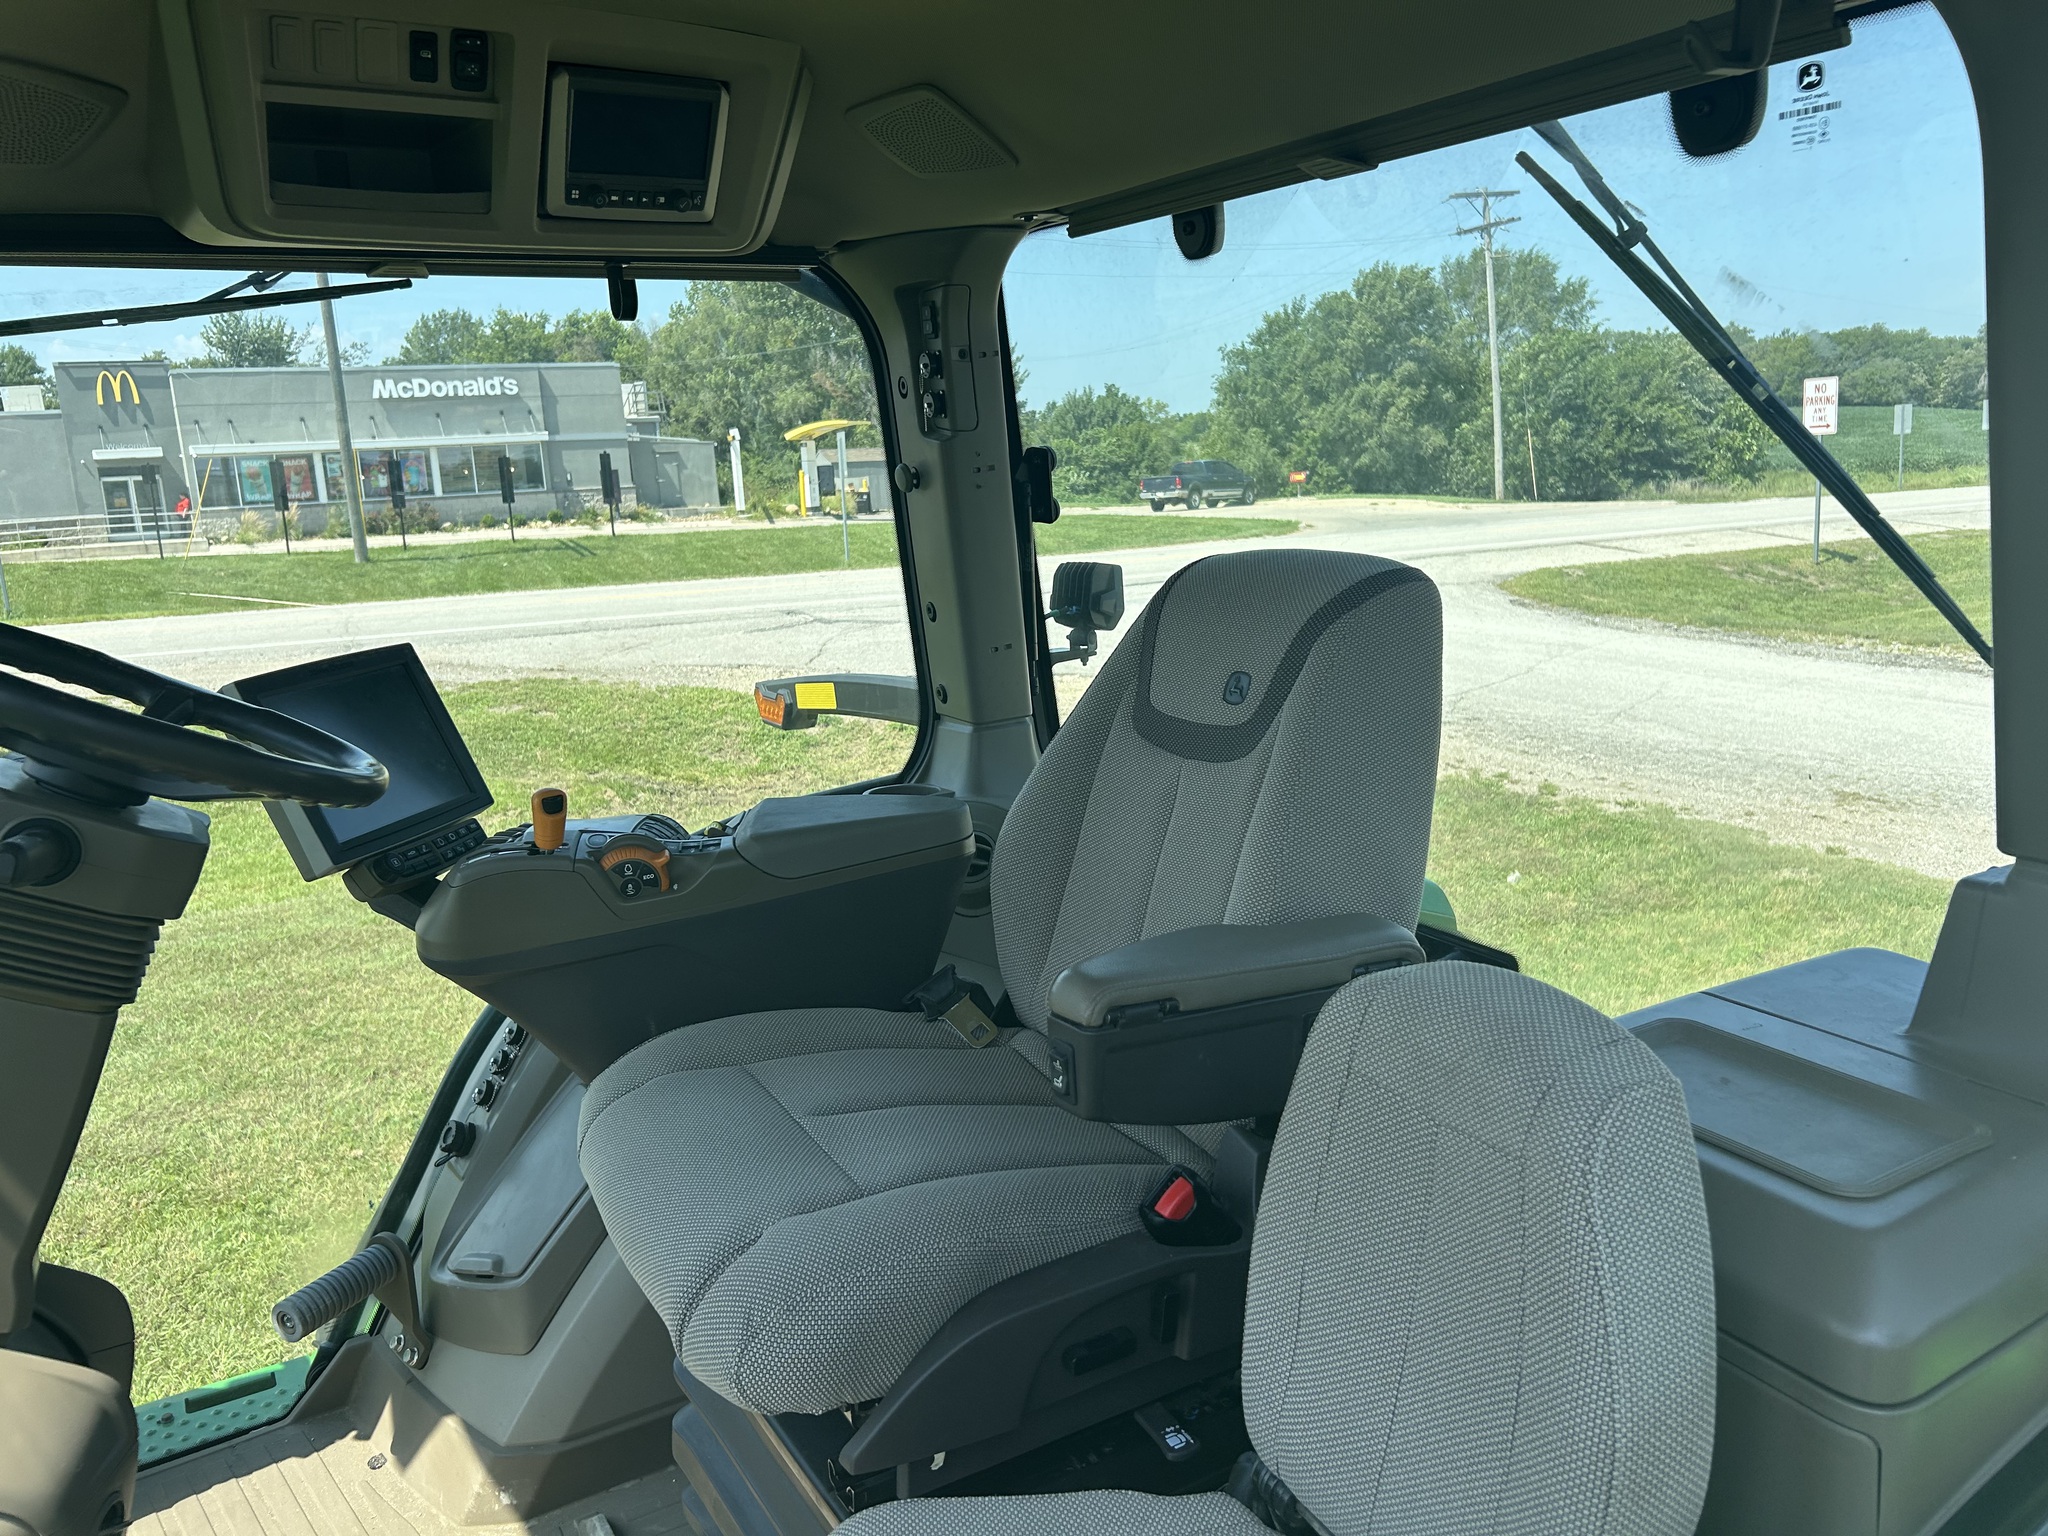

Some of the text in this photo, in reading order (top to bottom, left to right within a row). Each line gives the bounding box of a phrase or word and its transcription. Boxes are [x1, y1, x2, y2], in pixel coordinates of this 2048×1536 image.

[372, 376, 519, 399] McDonald's
[1814, 383, 1827, 394] NO
[1805, 395, 1835, 406] PARKING
